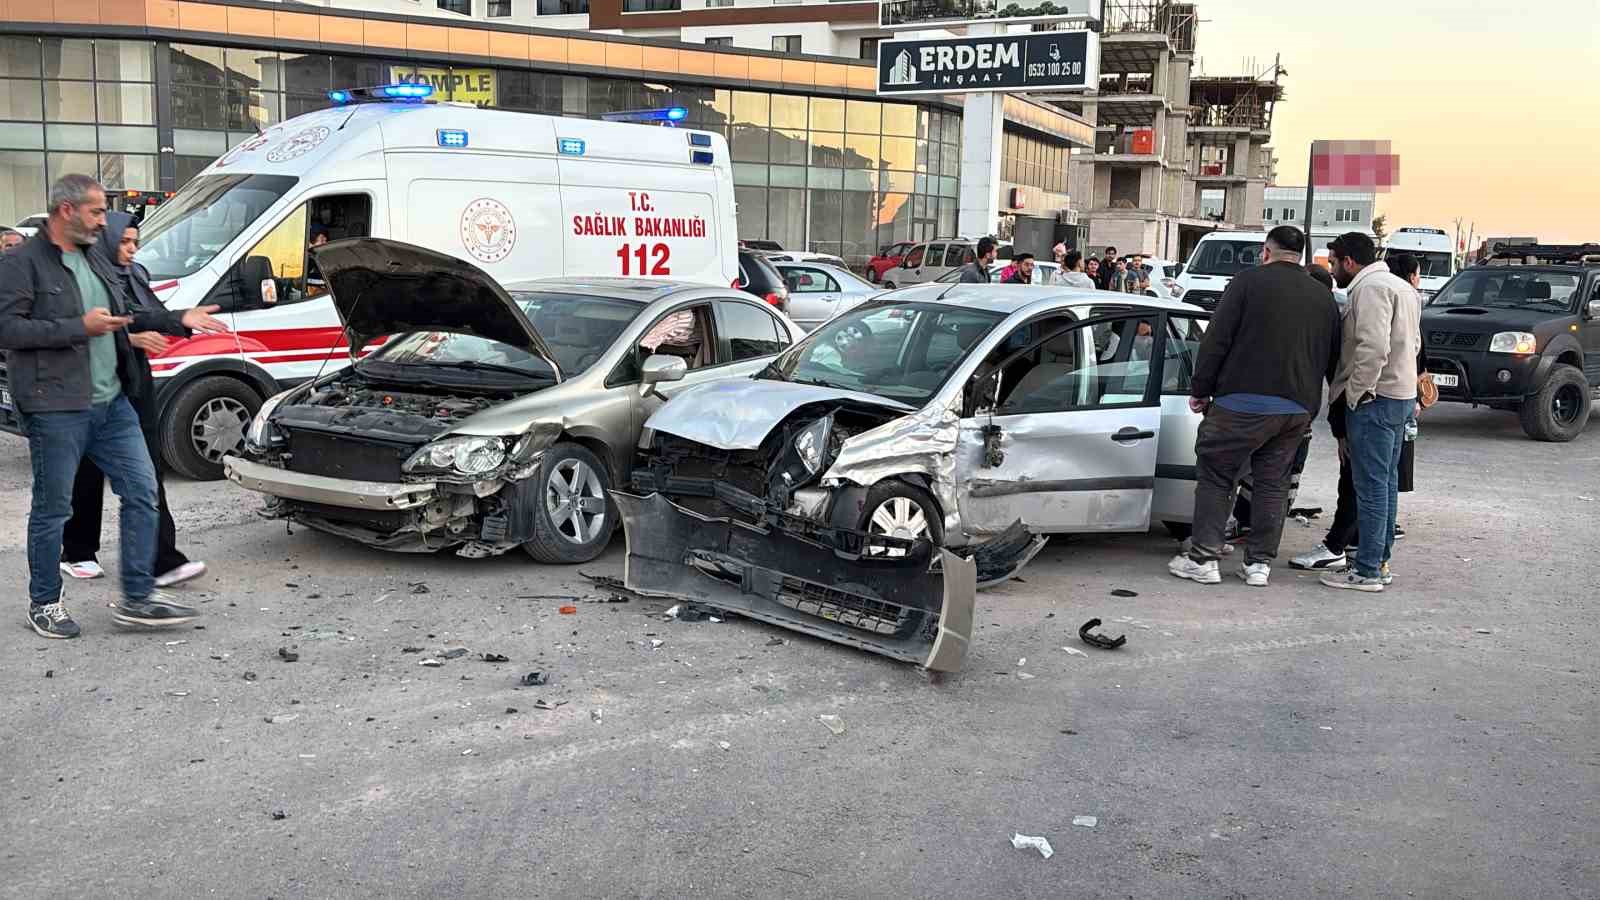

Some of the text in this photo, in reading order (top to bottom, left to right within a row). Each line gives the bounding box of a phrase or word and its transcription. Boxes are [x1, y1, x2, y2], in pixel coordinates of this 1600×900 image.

[919, 43, 1020, 71] ERDEM
[1028, 61, 1082, 77] 0532 100 25 00
[933, 72, 1003, 85] İNŞAAT
[628, 191, 655, 212] T.C.
[573, 211, 706, 238] SAĞLIK BAKANLIĞI
[616, 242, 671, 276] 112
